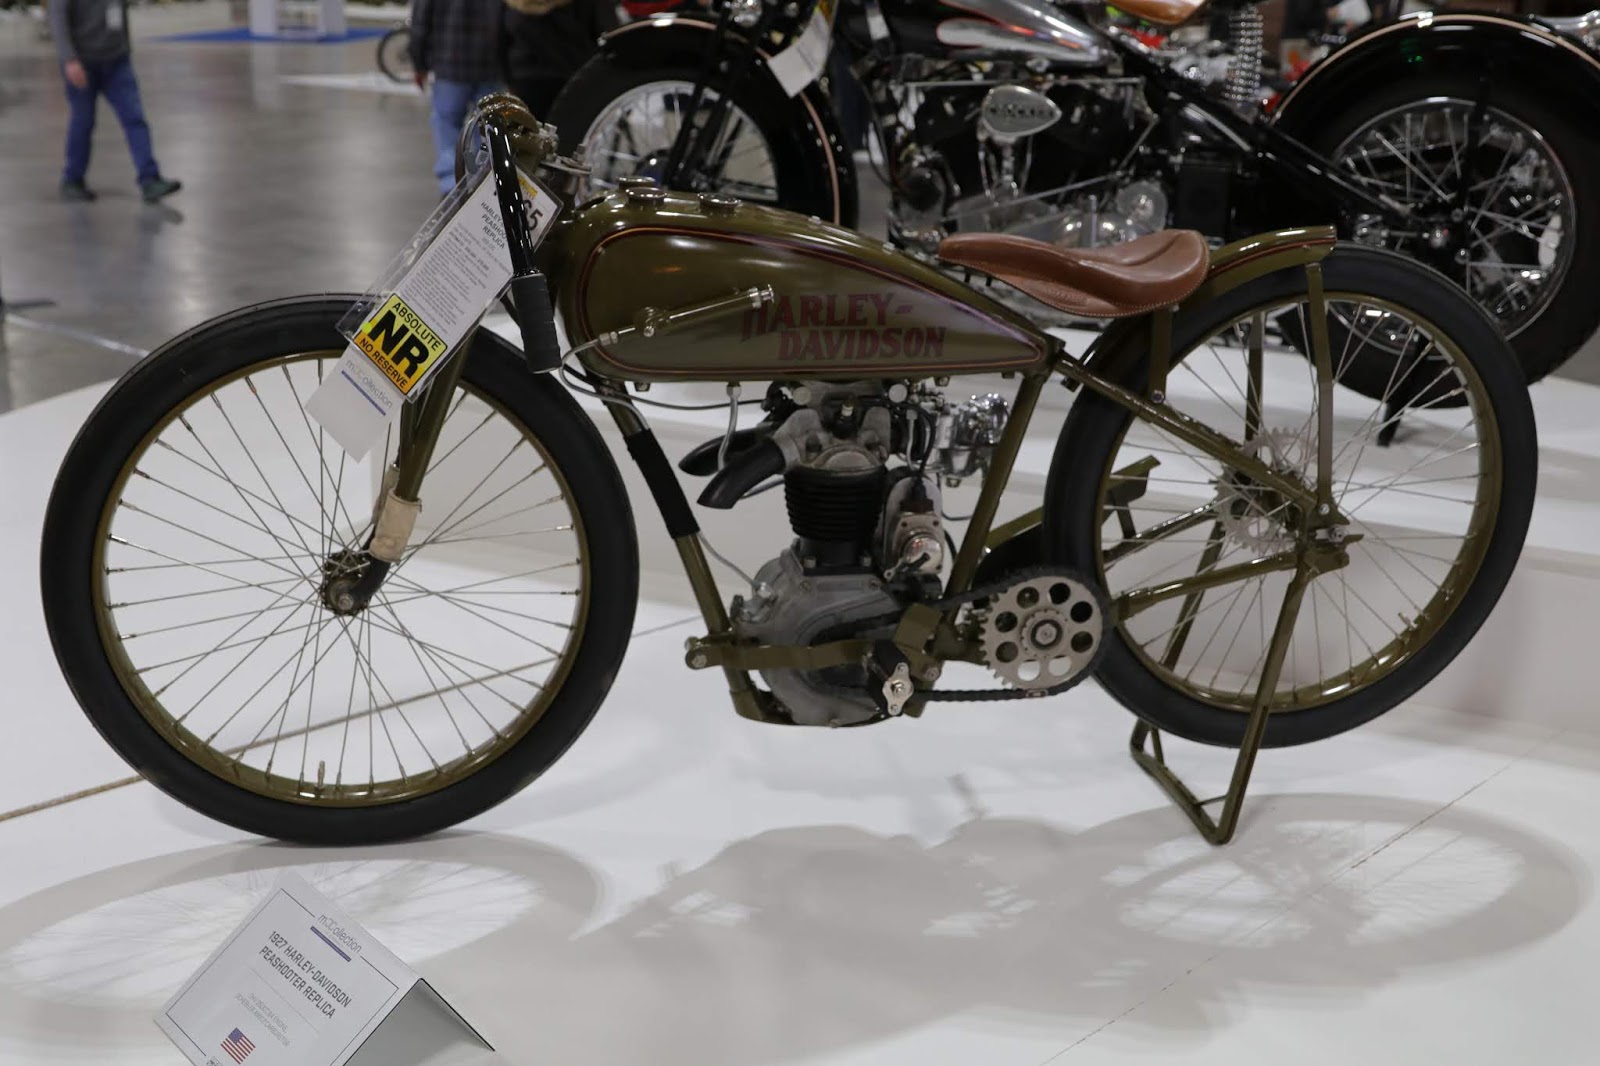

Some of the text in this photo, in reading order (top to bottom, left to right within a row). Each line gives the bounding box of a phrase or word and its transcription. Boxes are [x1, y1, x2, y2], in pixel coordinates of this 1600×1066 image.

[481, 213, 508, 240] PEASHOO
[482, 225, 505, 249] REPLICA
[367, 309, 429, 379] NR
[392, 302, 441, 351] ABSOLUTE
[778, 326, 947, 361] DAVIDSON
[359, 337, 408, 388] NO RESERVE
[259, 946, 307, 991] PEASHOOTER
[302, 985, 336, 1019] REPLICA
[268, 931, 288, 949] 1927
[283, 945, 352, 1008] HARLEY-DAVIDSON
